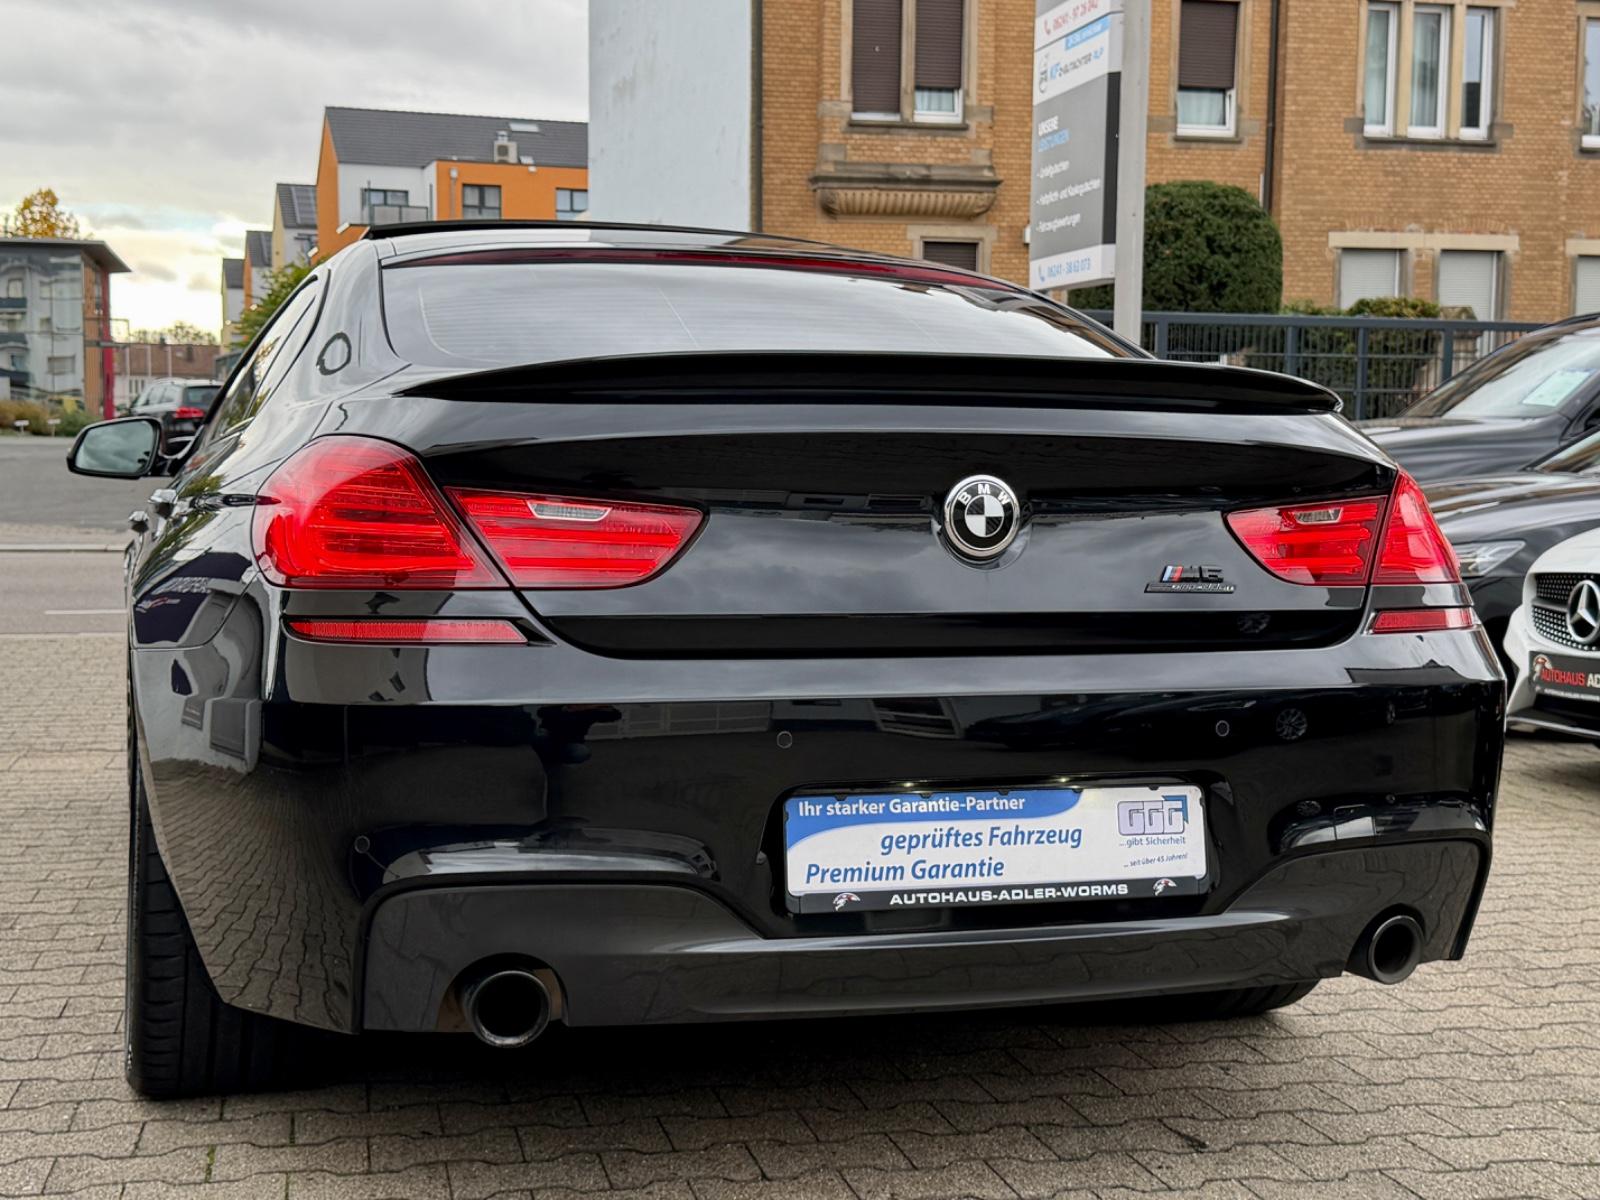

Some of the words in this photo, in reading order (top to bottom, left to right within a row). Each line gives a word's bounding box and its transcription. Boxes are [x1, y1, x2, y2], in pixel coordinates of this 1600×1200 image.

[957, 483, 1011, 506] BMW
[1541, 668, 1586, 687] AUTOHAUS
[799, 801, 822, 816] Ihr
[826, 802, 885, 816] starker
[889, 796, 1025, 813] Garantie-Partner
[1117, 799, 1186, 836] GGG
[881, 827, 983, 856] geprüftes
[988, 825, 1082, 848] Fahrzeug
[1146, 835, 1186, 846] Sicherheit
[806, 862, 904, 884] Premium
[911, 857, 1004, 880] Garantie
[889, 884, 1129, 905] AUTOHAUS-ADLER-WORMS
